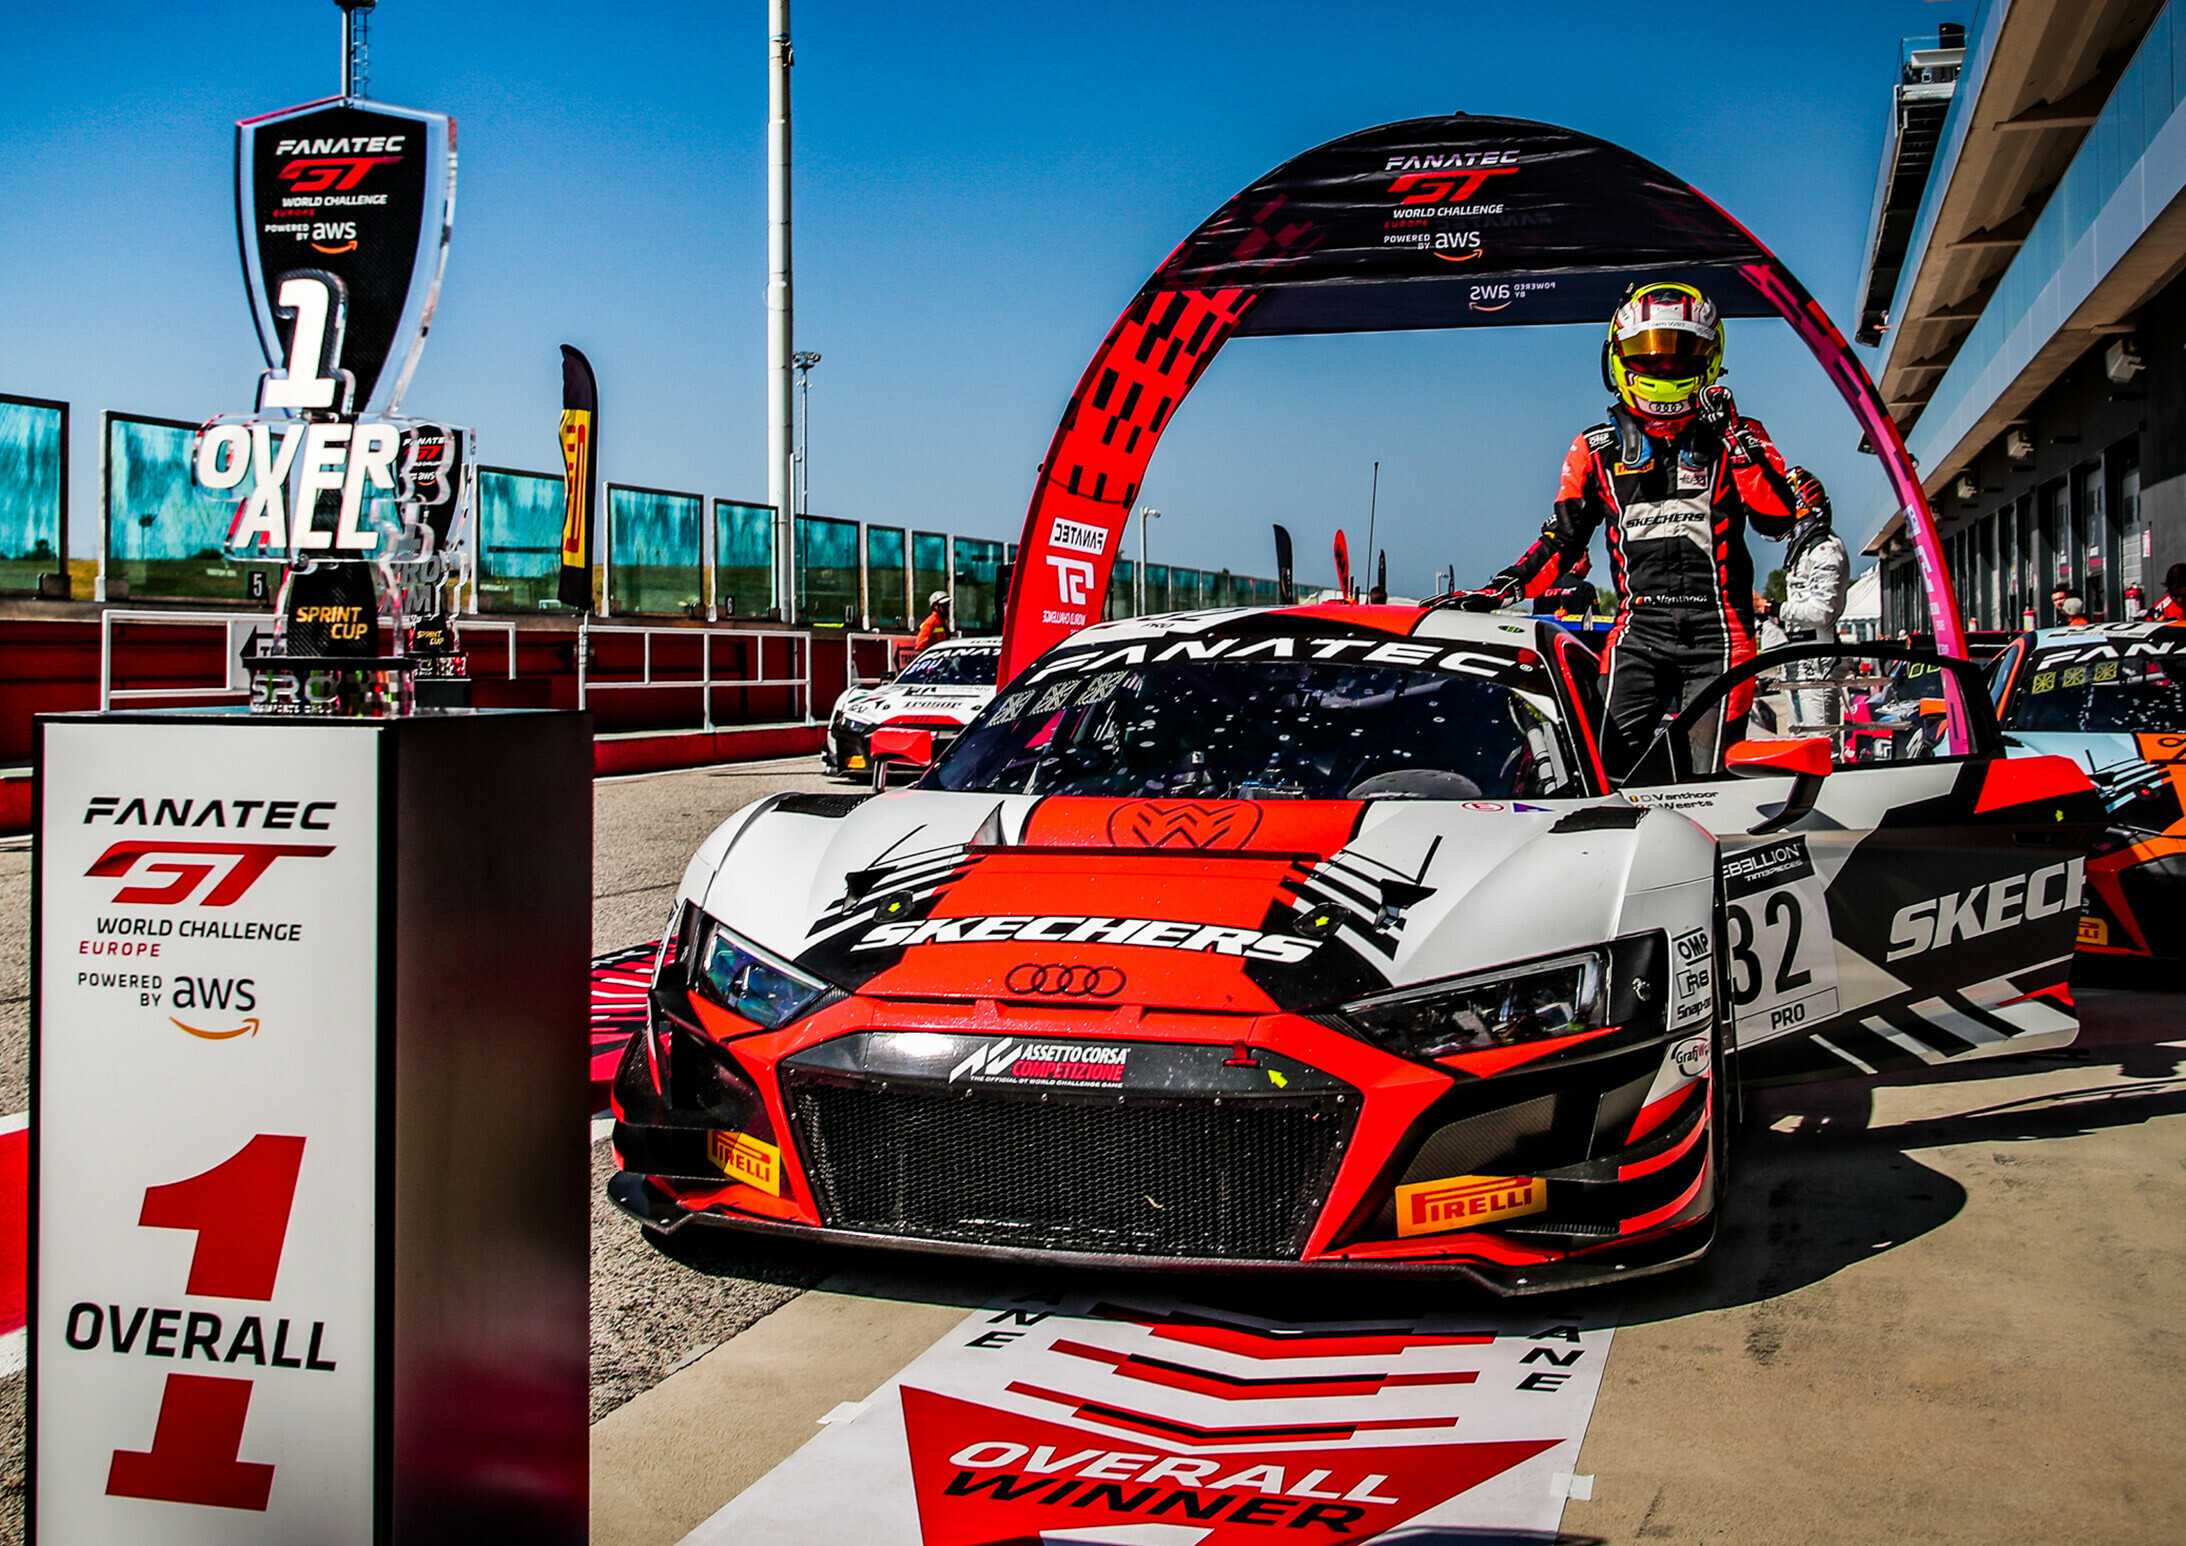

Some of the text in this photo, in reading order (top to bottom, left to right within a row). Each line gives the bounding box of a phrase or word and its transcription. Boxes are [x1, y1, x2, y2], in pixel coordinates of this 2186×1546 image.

[276, 136, 405, 155] FANATEC
[1385, 150, 1520, 171] FANATEC
[277, 156, 403, 192] GT
[1387, 167, 1520, 204] GT
[282, 194, 388, 207] WORLD CHALLENGE
[1393, 204, 1504, 219] WORLD CHALLENGE
[265, 224, 309, 233] POWERED
[312, 222, 357, 240] aws
[1384, 233, 1430, 244] POWERED
[1435, 231, 1481, 249] aws
[263, 278, 336, 408] 1
[197, 423, 401, 489] OVER
[233, 486, 379, 549] ALL
[1626, 513, 1705, 528] SKECHERS
[253, 573, 263, 597] 5
[296, 606, 363, 623] SPRINT
[331, 623, 369, 640] CUP
[1025, 637, 1516, 686] FANATEC
[83, 796, 338, 831] FANATEC
[83, 840, 338, 907] GT
[97, 917, 302, 942] WORLD CHALLENGE
[850, 915, 1324, 964] SKECHERS
[79, 941, 161, 958] EUROPE
[1677, 932, 1708, 960] OMP
[1726, 891, 1812, 1006] 32
[78, 973, 162, 989] POWERED
[172, 975, 257, 1012] aws
[140, 993, 162, 1007] BY
[1771, 1003, 1805, 1031] PRO
[1020, 1044, 1127, 1065] ASSETTO CORSA
[985, 1076, 1018, 1084] OFFICIAL
[1056, 1080, 1100, 1088] CHALLENGE
[1011, 1060, 1126, 1082] COMPETIZIONE
[712, 1130, 771, 1183] PIRELLI
[1411, 1176, 1533, 1226] PIRELLI
[65, 1301, 337, 1372] OVERALL
[949, 1441, 1399, 1505] OVERALL
[943, 1470, 1366, 1534] WINNER
